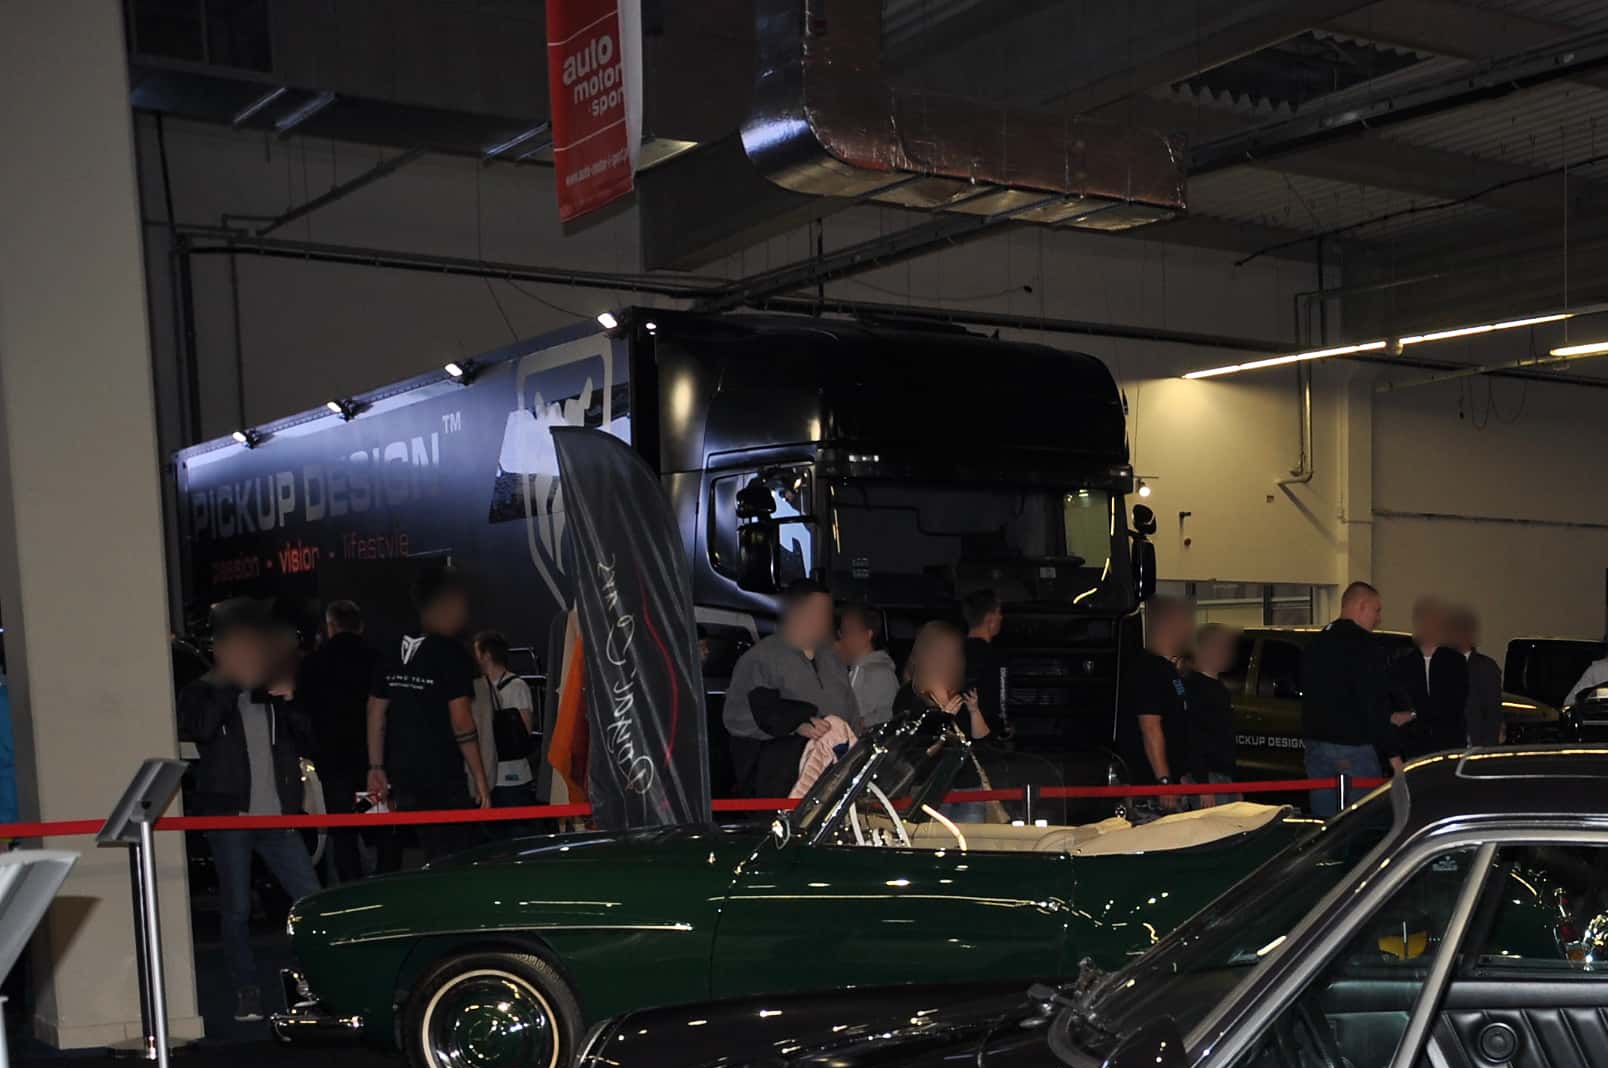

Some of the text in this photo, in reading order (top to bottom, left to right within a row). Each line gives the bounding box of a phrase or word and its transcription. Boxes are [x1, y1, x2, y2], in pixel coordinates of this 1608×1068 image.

[563, 35, 613, 86] auto
[191, 471, 296, 542] PICKUP
[303, 432, 441, 522] DESIGN
[279, 542, 320, 574] vision
[1233, 735, 1265, 747] ICKUP
